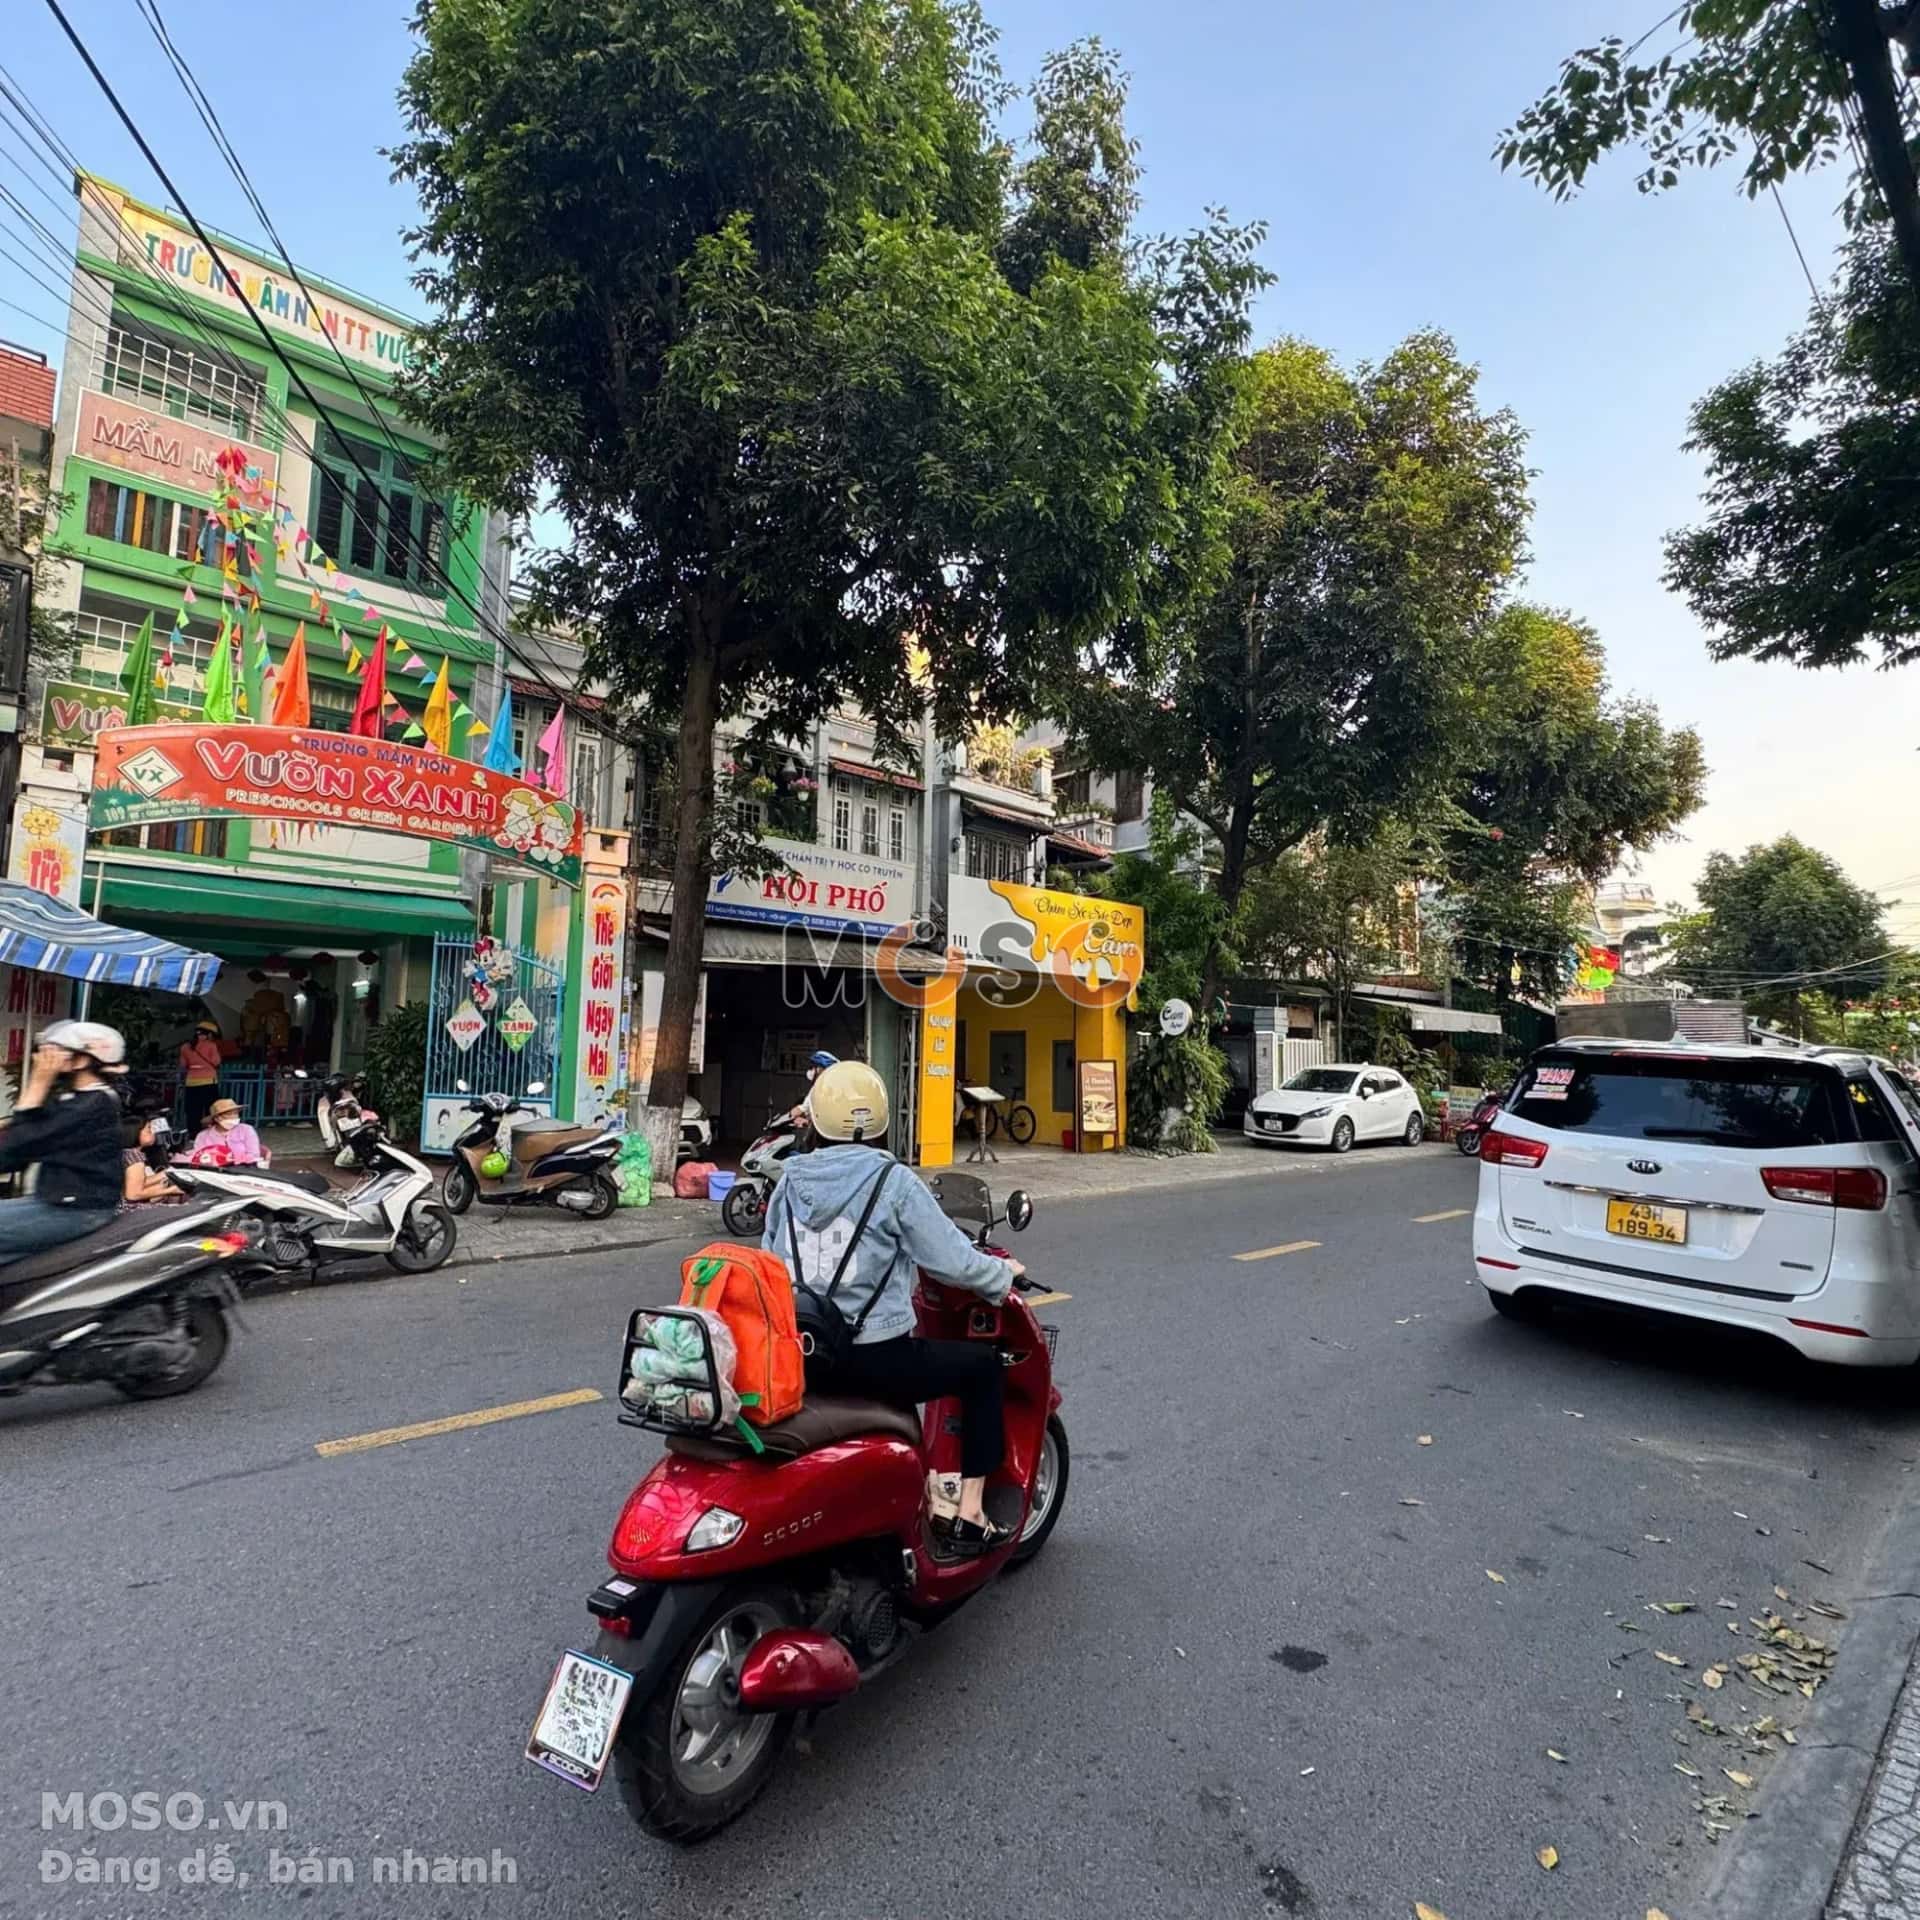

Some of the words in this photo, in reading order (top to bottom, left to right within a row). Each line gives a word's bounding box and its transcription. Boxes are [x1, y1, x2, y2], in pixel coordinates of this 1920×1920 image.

[93, 415, 182, 467] MẦM
[132, 767, 163, 783] VX
[195, 738, 354, 799] VƯỜN
[362, 766, 497, 822] XANH
[226, 788, 343, 817] PRESCHOOLS
[346, 806, 403, 827] GREEN
[407, 815, 473, 836] GARDEN
[762, 873, 819, 907] HỘI
[827, 881, 888, 913] PHỐ
[1632, 1160, 1657, 1172] KIA
